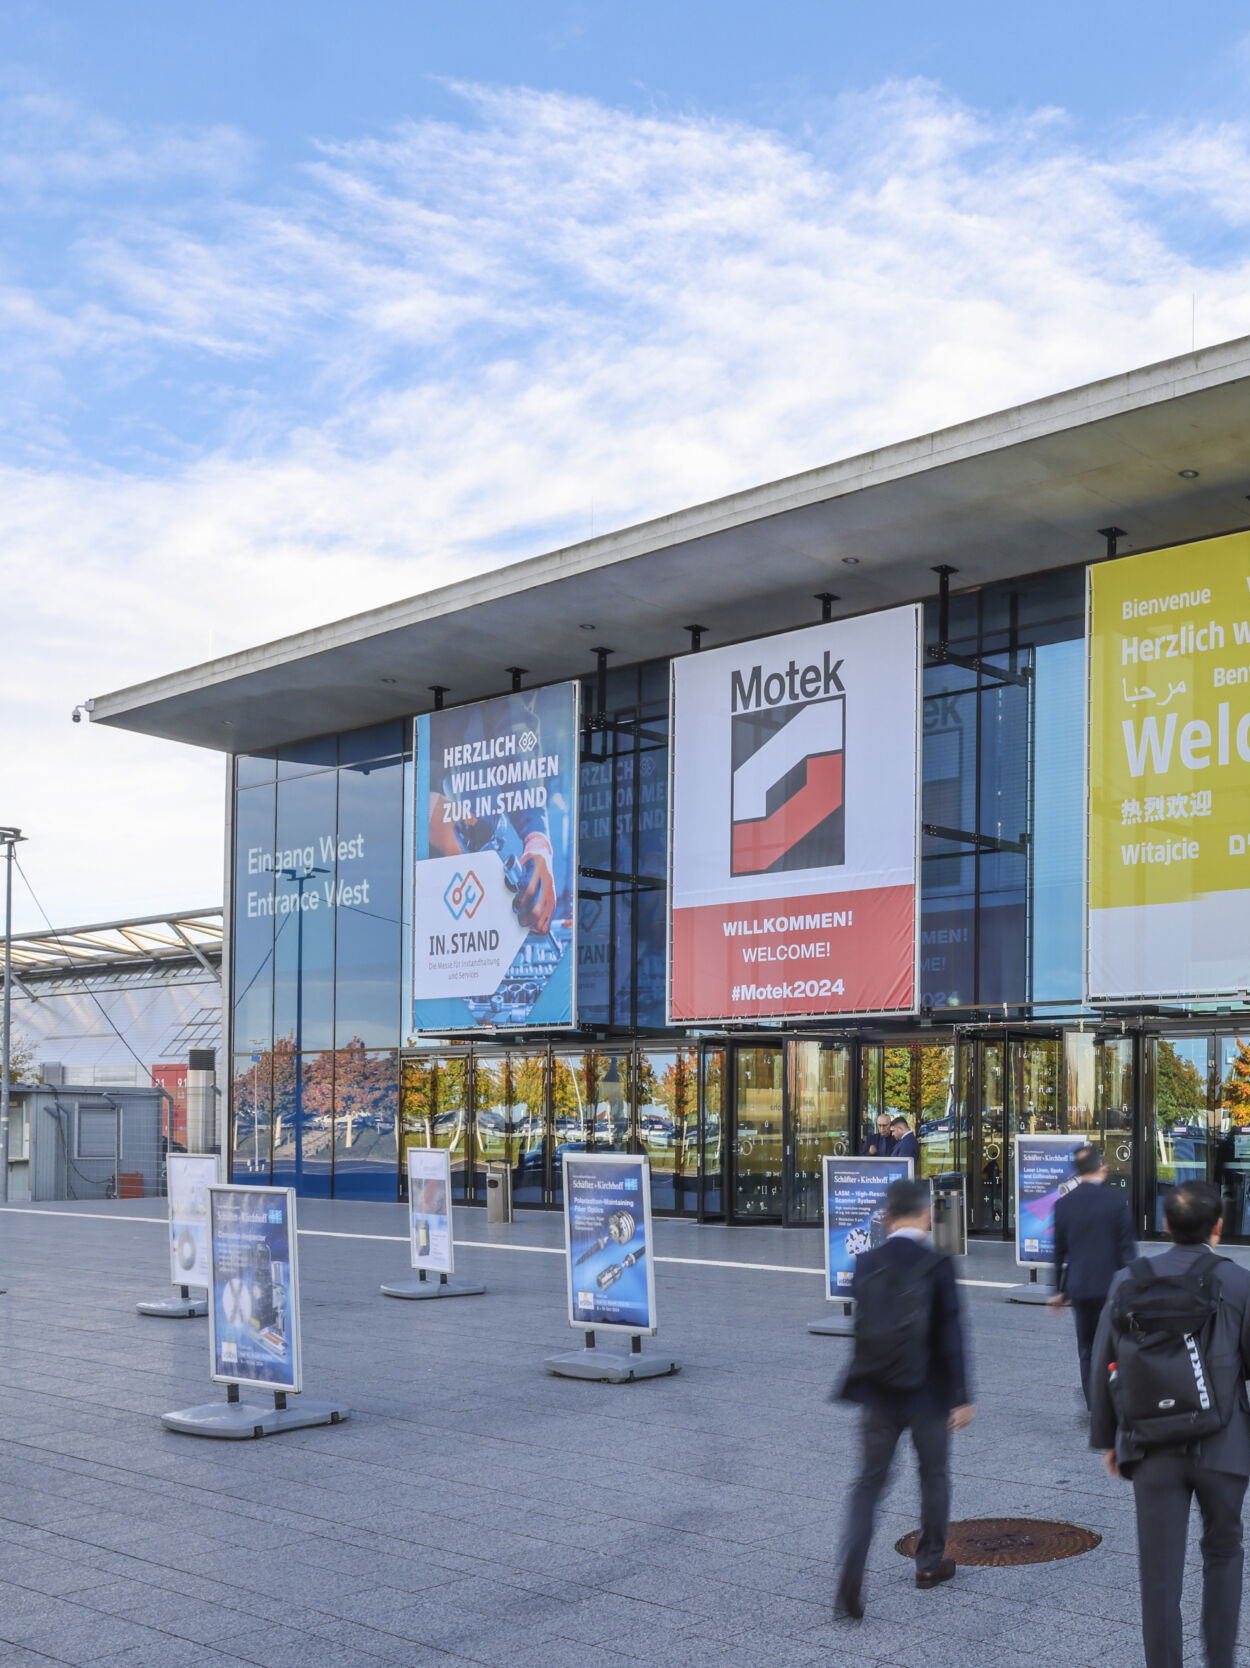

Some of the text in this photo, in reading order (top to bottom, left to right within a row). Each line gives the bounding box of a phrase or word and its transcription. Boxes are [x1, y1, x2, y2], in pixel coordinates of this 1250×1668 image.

[1122, 587, 1212, 620] Bienvenue
[1122, 620, 1224, 666] Herzlich
[731, 650, 846, 713] Motek
[1122, 678, 1186, 708] مرحبا
[444, 734, 516, 768] HERZLICH
[452, 754, 559, 794] WILLKOMMEN
[443, 786, 547, 824] ZUR IN.STAND
[1122, 790, 1212, 825] 热烈欢迎
[248, 834, 364, 878] Eingang West
[1121, 837, 1200, 866] Witajcie
[248, 879, 370, 918] Entrance West
[723, 911, 854, 937] WILLKOMMEN!
[430, 930, 499, 956] IN.STAND
[742, 942, 831, 963] WELCOME!
[732, 979, 845, 1001] #Motek2024
[598, 1180, 624, 1190] Kirchhoff
[860, 1176, 888, 1184] Kirchhoff
